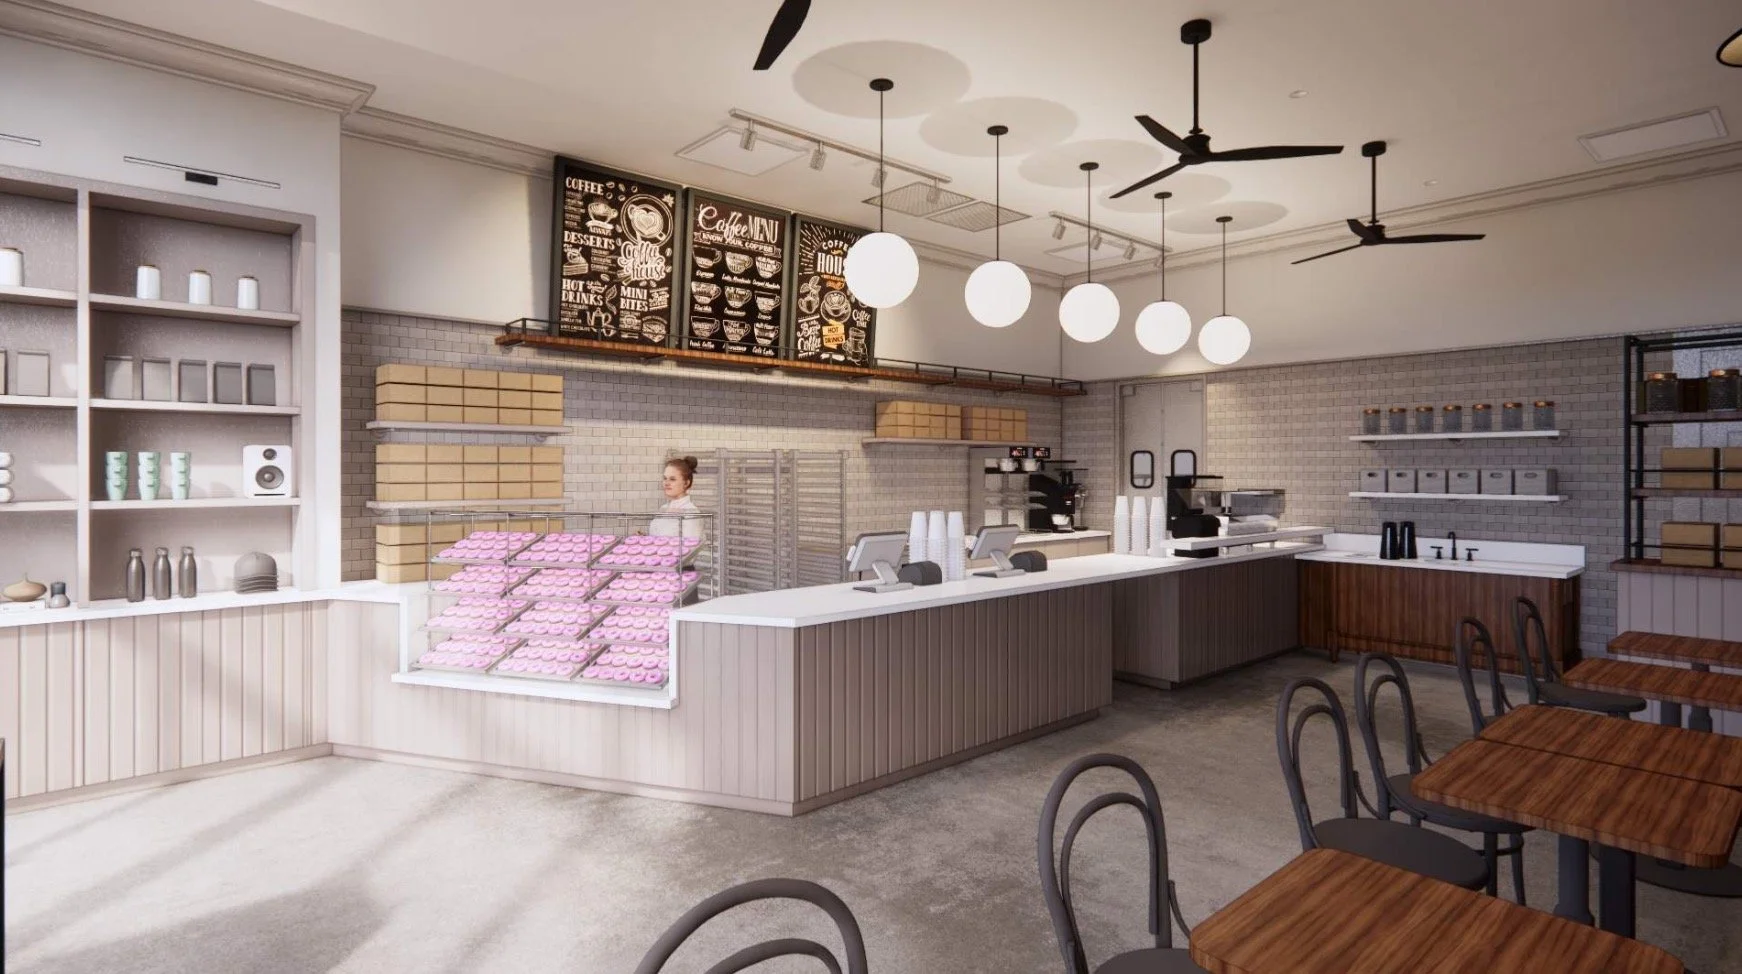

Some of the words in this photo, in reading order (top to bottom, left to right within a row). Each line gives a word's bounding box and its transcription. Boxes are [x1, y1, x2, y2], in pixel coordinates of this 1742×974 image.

[566, 177, 604, 195] COFFEE
[698, 204, 748, 239] Coffee
[748, 215, 779, 244] MENU
[564, 231, 615, 250] DESSERTS
[702, 233, 723, 242] KNOW
[725, 238, 743, 247] YOUR
[745, 242, 773, 253] COFFEE
[822, 240, 849, 252] COFFE
[620, 241, 660, 268] Coffee
[817, 252, 842, 276] HOU
[562, 279, 584, 291] HOT
[620, 286, 648, 300] MINI
[561, 290, 603, 306] DRINKS
[619, 298, 649, 313] BITES
[852, 309, 872, 322] Coffee
[797, 336, 821, 352] Coffee
